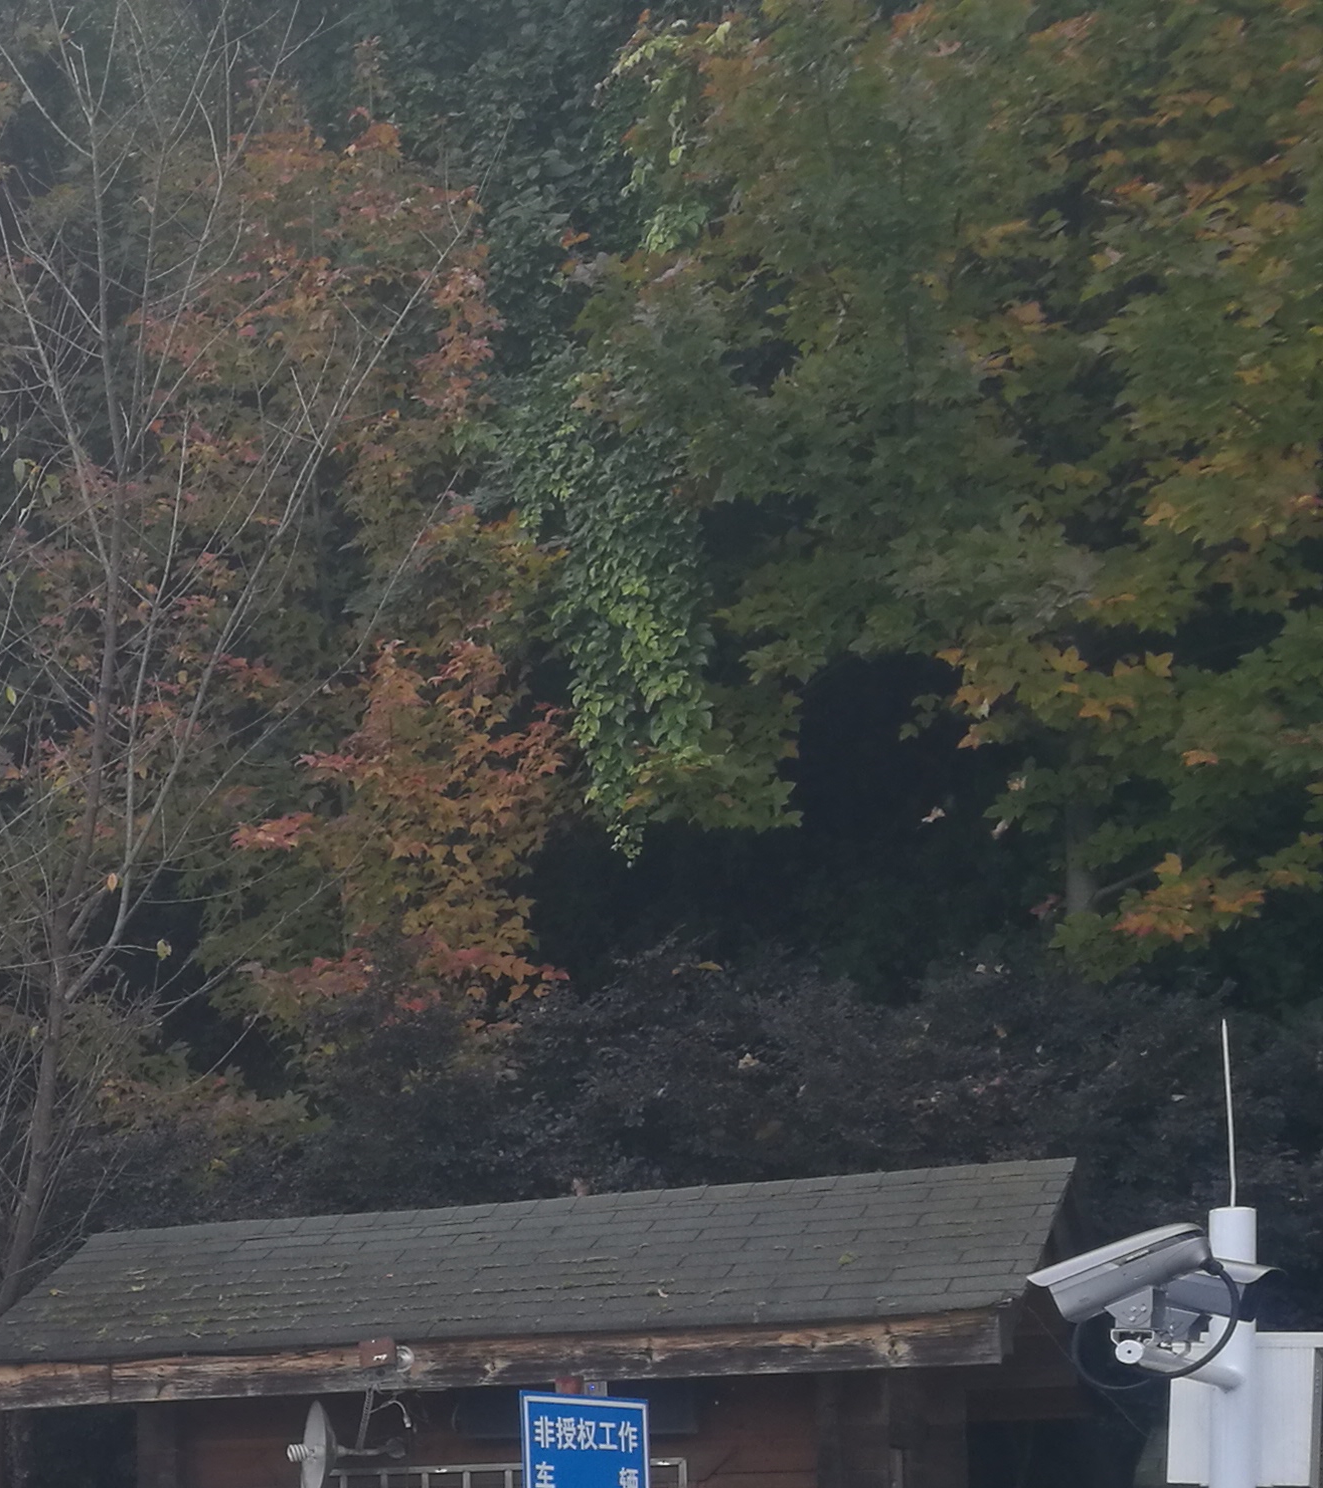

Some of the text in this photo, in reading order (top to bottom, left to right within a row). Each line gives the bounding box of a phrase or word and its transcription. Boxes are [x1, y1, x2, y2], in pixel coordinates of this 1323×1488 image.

[533, 1415, 639, 1454] 非授权工作
